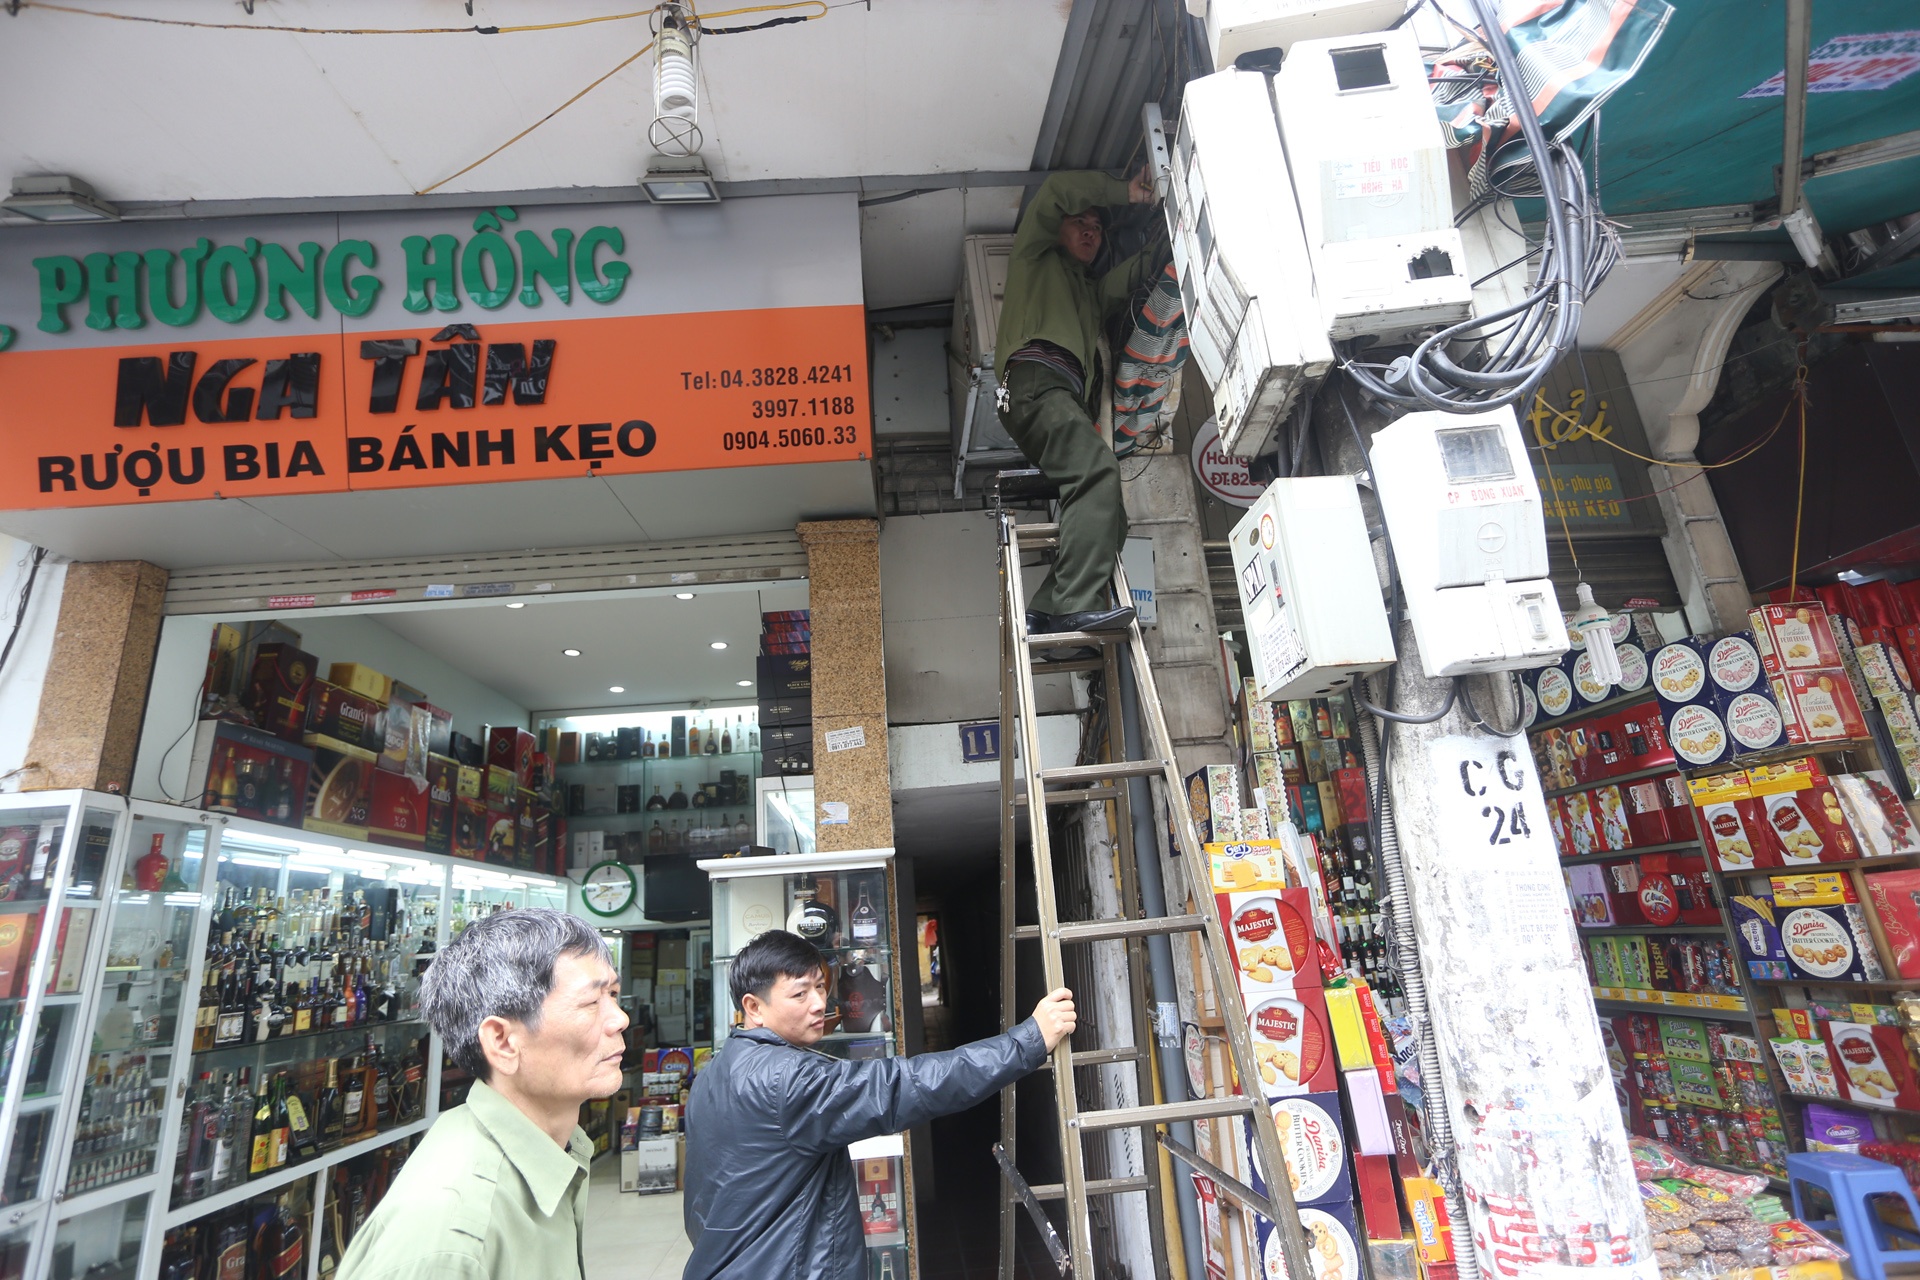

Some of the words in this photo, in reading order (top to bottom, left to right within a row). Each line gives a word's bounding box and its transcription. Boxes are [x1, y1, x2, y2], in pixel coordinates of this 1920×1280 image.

[32, 237, 382, 333] PHƯƠNG
[401, 205, 631, 313] HỒNG
[114, 351, 321, 427] NGA
[360, 323, 556, 414] TÂN
[752, 396, 855, 418] 3997.1188
[723, 426, 857, 451] 0904.5060.33
[38, 442, 205, 496] RƯỢU
[223, 440, 326, 481] BIA
[348, 425, 515, 473] BÁNH
[534, 420, 657, 469] KẸO
[1660, 652, 1685, 671] Danisa
[1717, 644, 1741, 662] Danisa
[340, 702, 366, 722] Grant's
[1736, 701, 1760, 718] Danisa
[1679, 713, 1705, 731] Danisa
[967, 730, 995, 756] 11
[1482, 802, 1531, 845] 24
[1714, 821, 1738, 830] MAJESTIC
[1775, 811, 1798, 828] MAJESTIC
[1224, 842, 1253, 860] Gery
[1237, 918, 1274, 933] MAJESTIC
[1793, 920, 1827, 936] Danisa
[1651, 943, 1668, 979] RIESEN
[1258, 1018, 1296, 1030] MAJESTIC
[1842, 1047, 1872, 1055] MAJESTIC
[1303, 1117, 1326, 1171] Danisa
